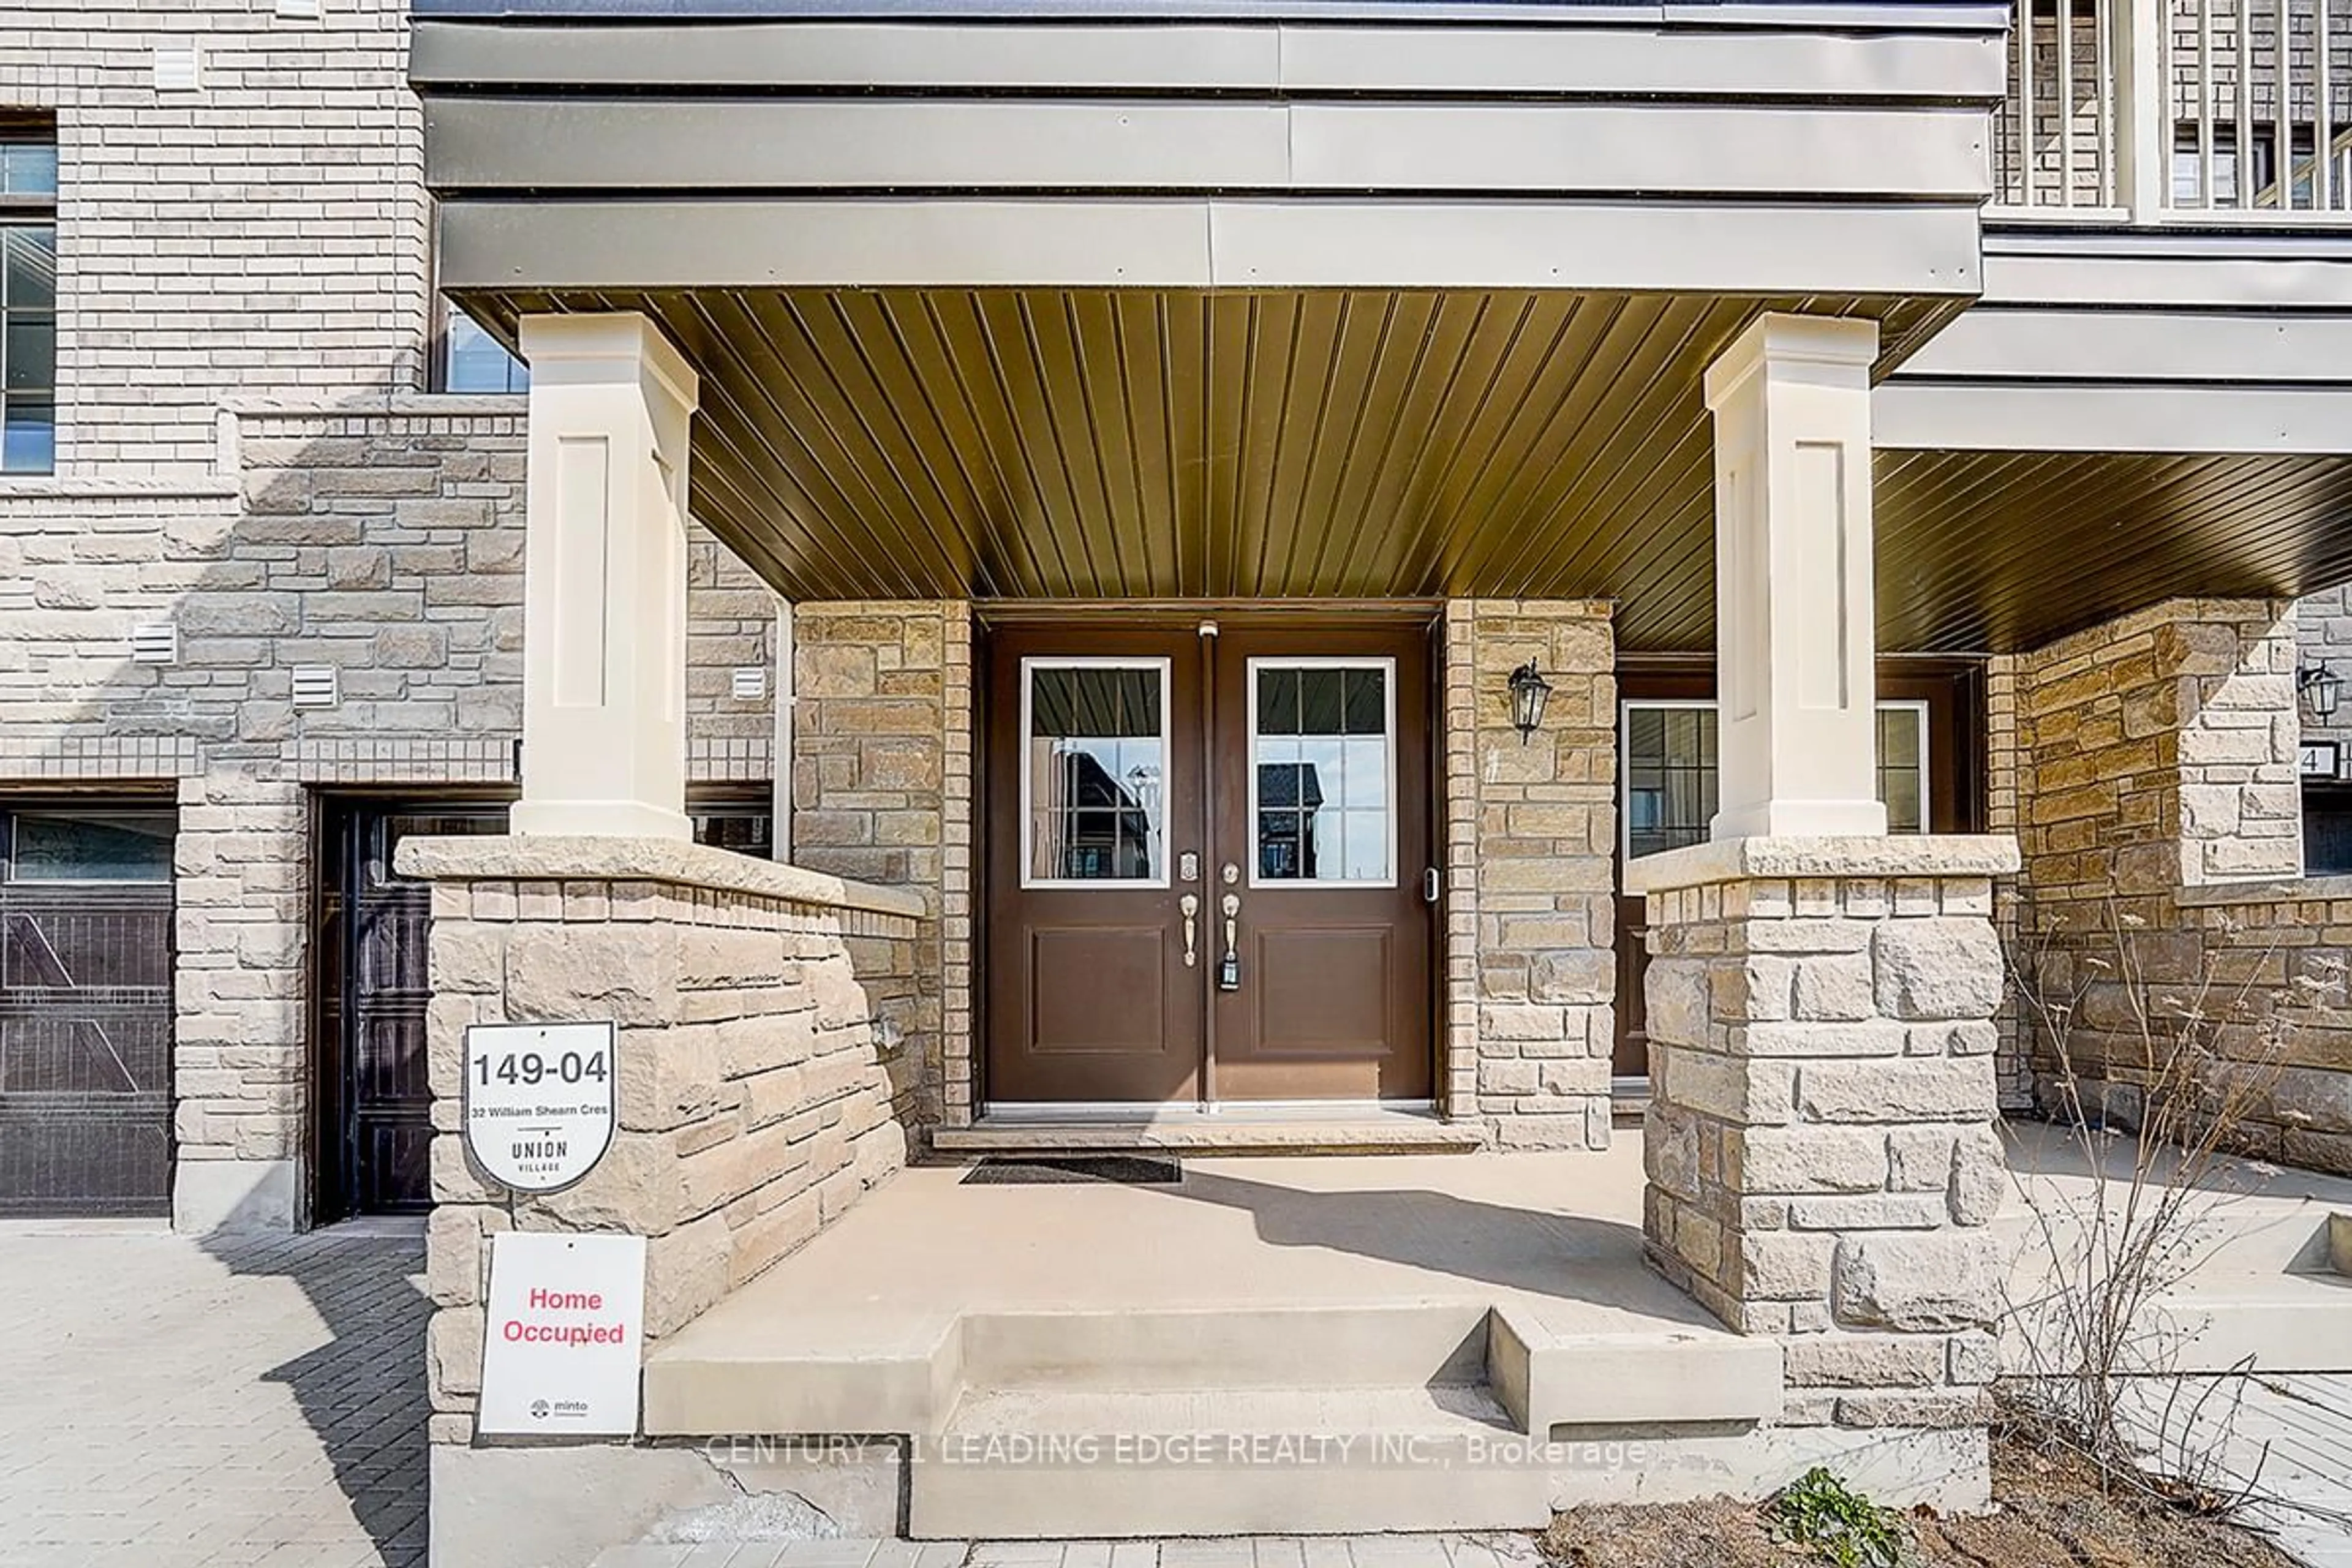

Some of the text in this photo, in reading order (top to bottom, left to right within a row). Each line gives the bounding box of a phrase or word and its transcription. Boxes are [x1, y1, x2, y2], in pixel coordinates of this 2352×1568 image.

[2301, 749, 2318, 771] 4
[473, 1051, 607, 1085] 149-04
[488, 1106, 532, 1117] William
[535, 1105, 578, 1116] Shearn
[580, 1104, 608, 1115] Cres
[511, 1141, 567, 1159] UNION
[518, 1163, 560, 1172] VILLAGE
[529, 1288, 603, 1310] Home
[503, 1321, 624, 1347] Occupied
[554, 1400, 588, 1411] minto
